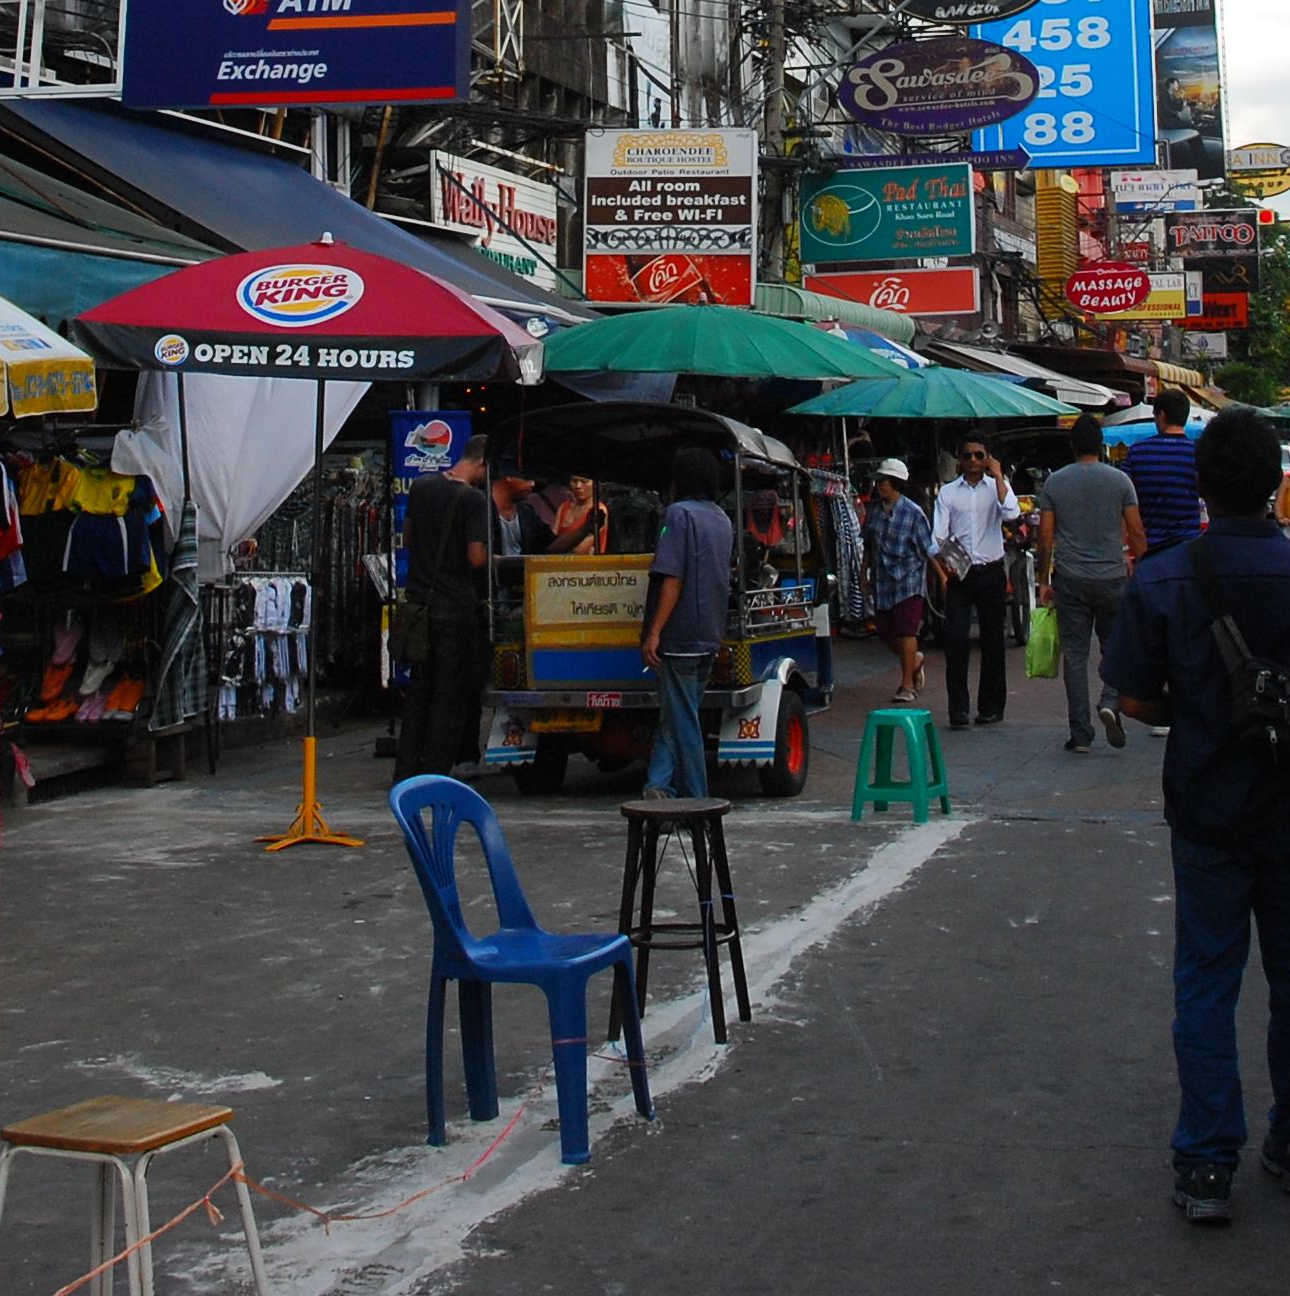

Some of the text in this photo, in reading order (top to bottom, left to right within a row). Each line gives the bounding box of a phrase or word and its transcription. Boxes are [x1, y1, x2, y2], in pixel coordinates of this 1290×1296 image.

[1002, 16, 1111, 52] 458
[217, 60, 327, 83] Exchange
[848, 53, 1013, 111] Sawasdee
[1023, 111, 1096, 146] 88
[626, 156, 713, 165] BOUTIQUE HOSTEL
[628, 180, 701, 192] All room
[440, 170, 557, 249] Wally House
[591, 194, 747, 206] included breakfast
[886, 200, 963, 212] RESTAURANT
[614, 209, 723, 221] & Free WI-FI
[1169, 223, 1255, 247] TATTOO
[256, 274, 348, 292] BURGER
[254, 284, 349, 307] KING
[160, 347, 185, 359] KING
[194, 343, 415, 369] OPEN 24 HOURS
